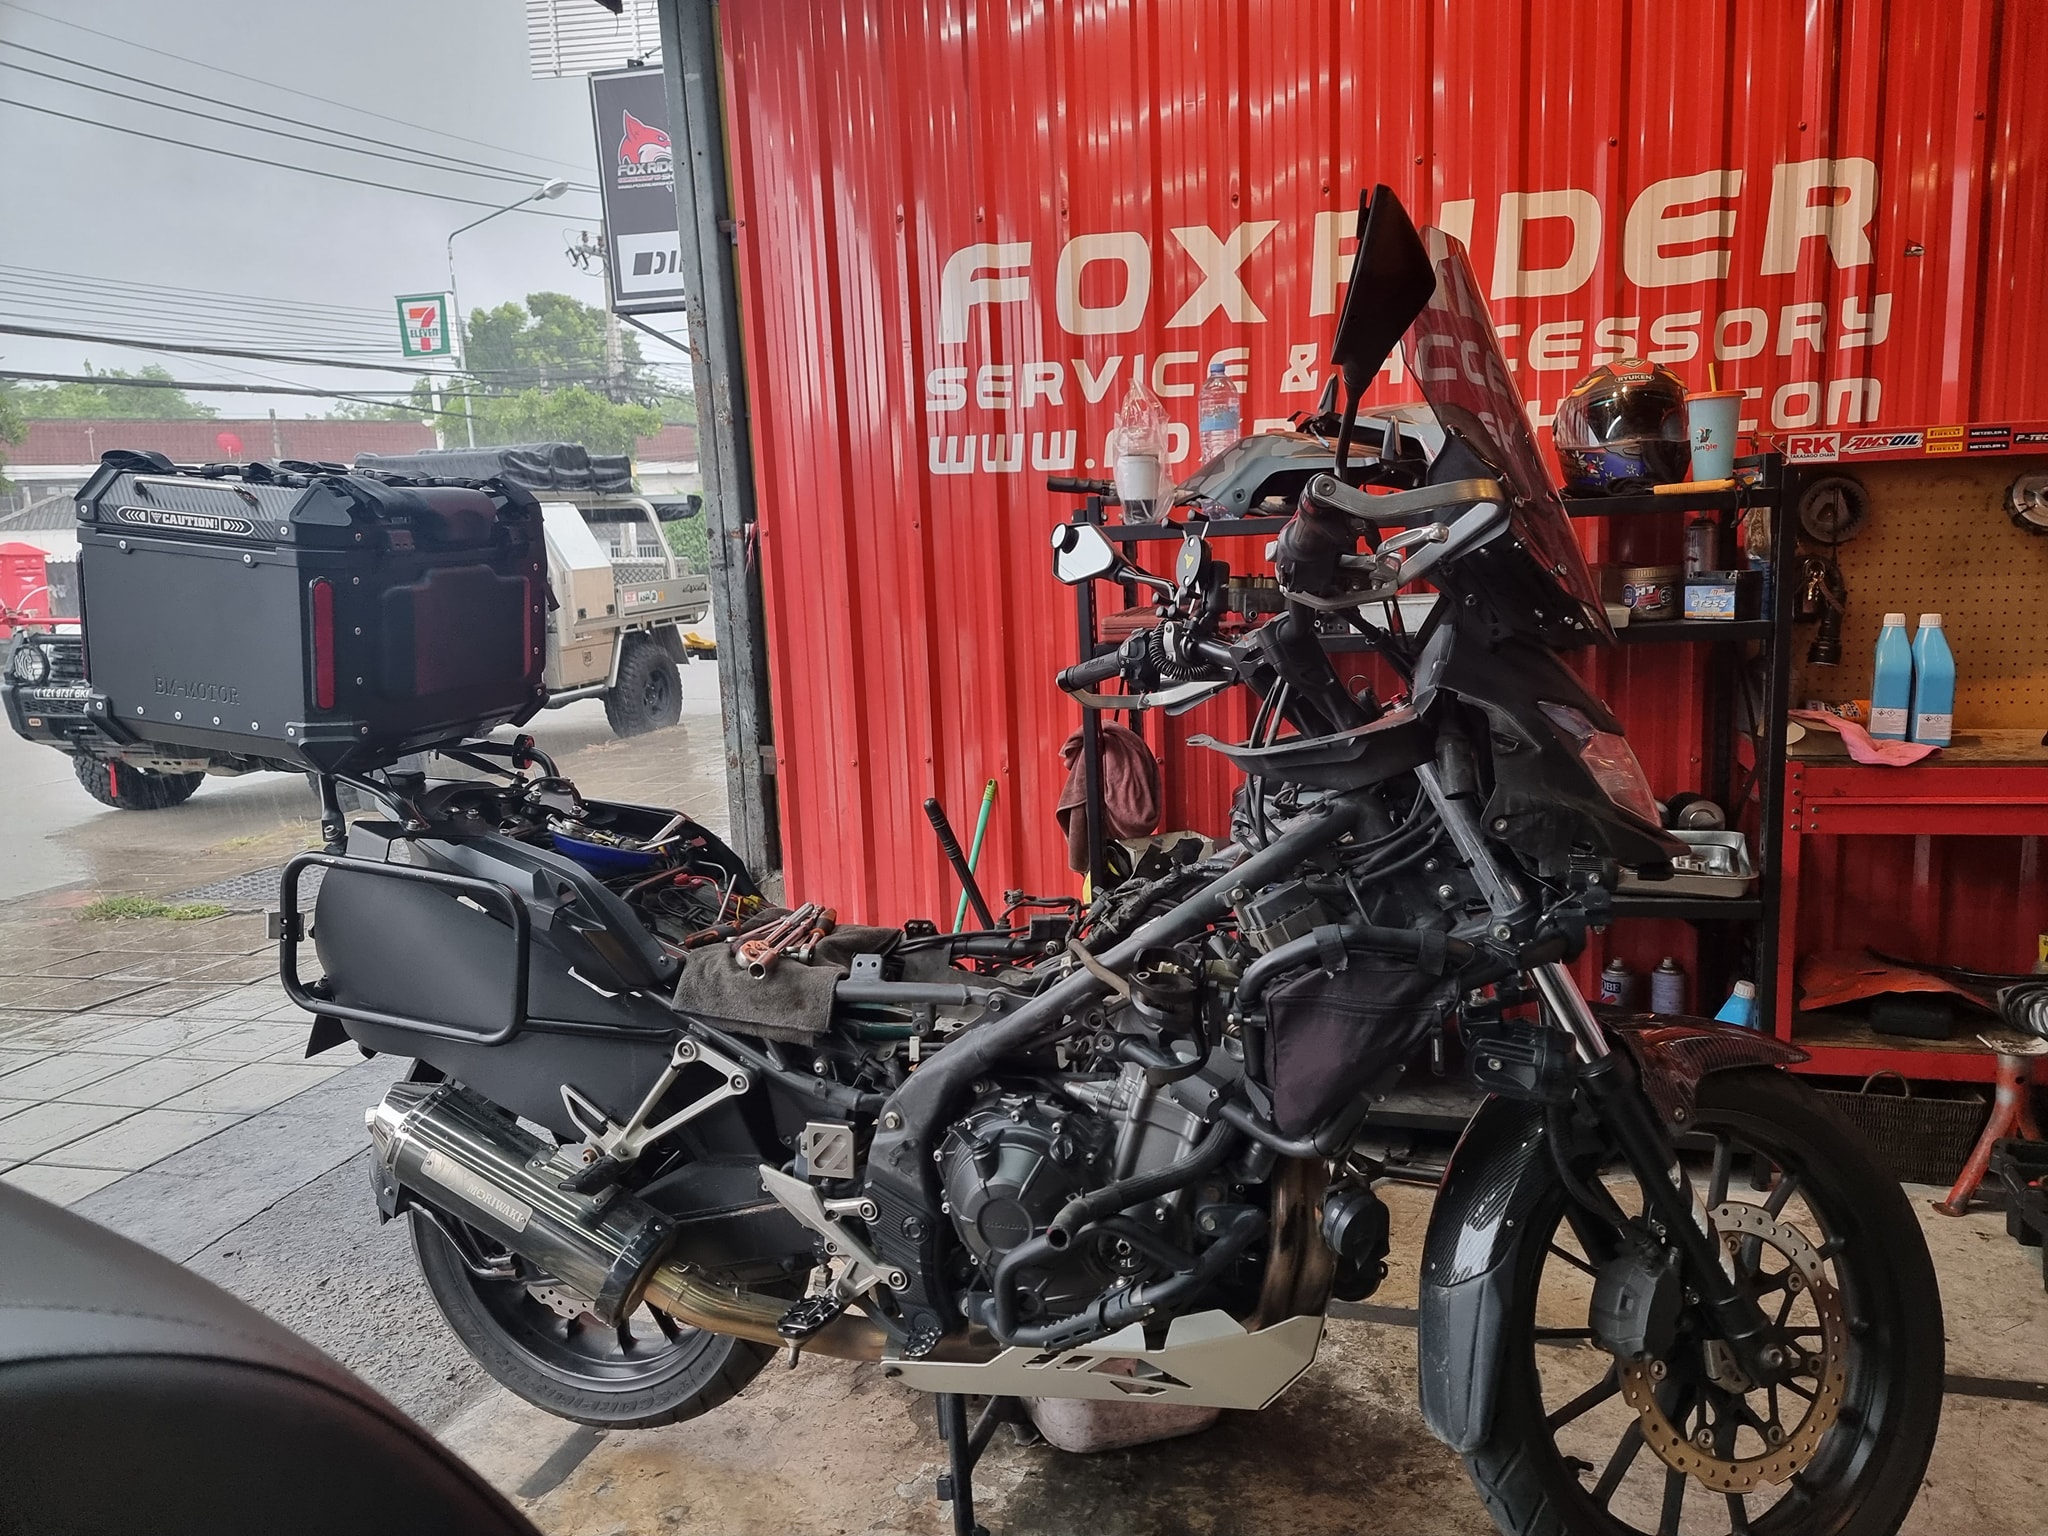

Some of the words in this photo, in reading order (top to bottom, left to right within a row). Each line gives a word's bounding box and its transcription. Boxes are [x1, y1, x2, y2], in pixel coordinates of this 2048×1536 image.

[617, 163, 646, 176] FOX
[939, 220, 1280, 344] FOX
[408, 306, 435, 351] 7
[926, 347, 1250, 412] SERVICE
[1280, 342, 1318, 392] &
[1617, 374, 1652, 382] RYUKEN
[1694, 443, 1718, 452] jungle
[1790, 436, 1836, 454] RK
[1846, 434, 1922, 450] AMSOIL
[162, 513, 218, 529] CAUTION!
[154, 676, 241, 705] BM-MOTOR
[467, 1183, 524, 1222] MORIWAKI
